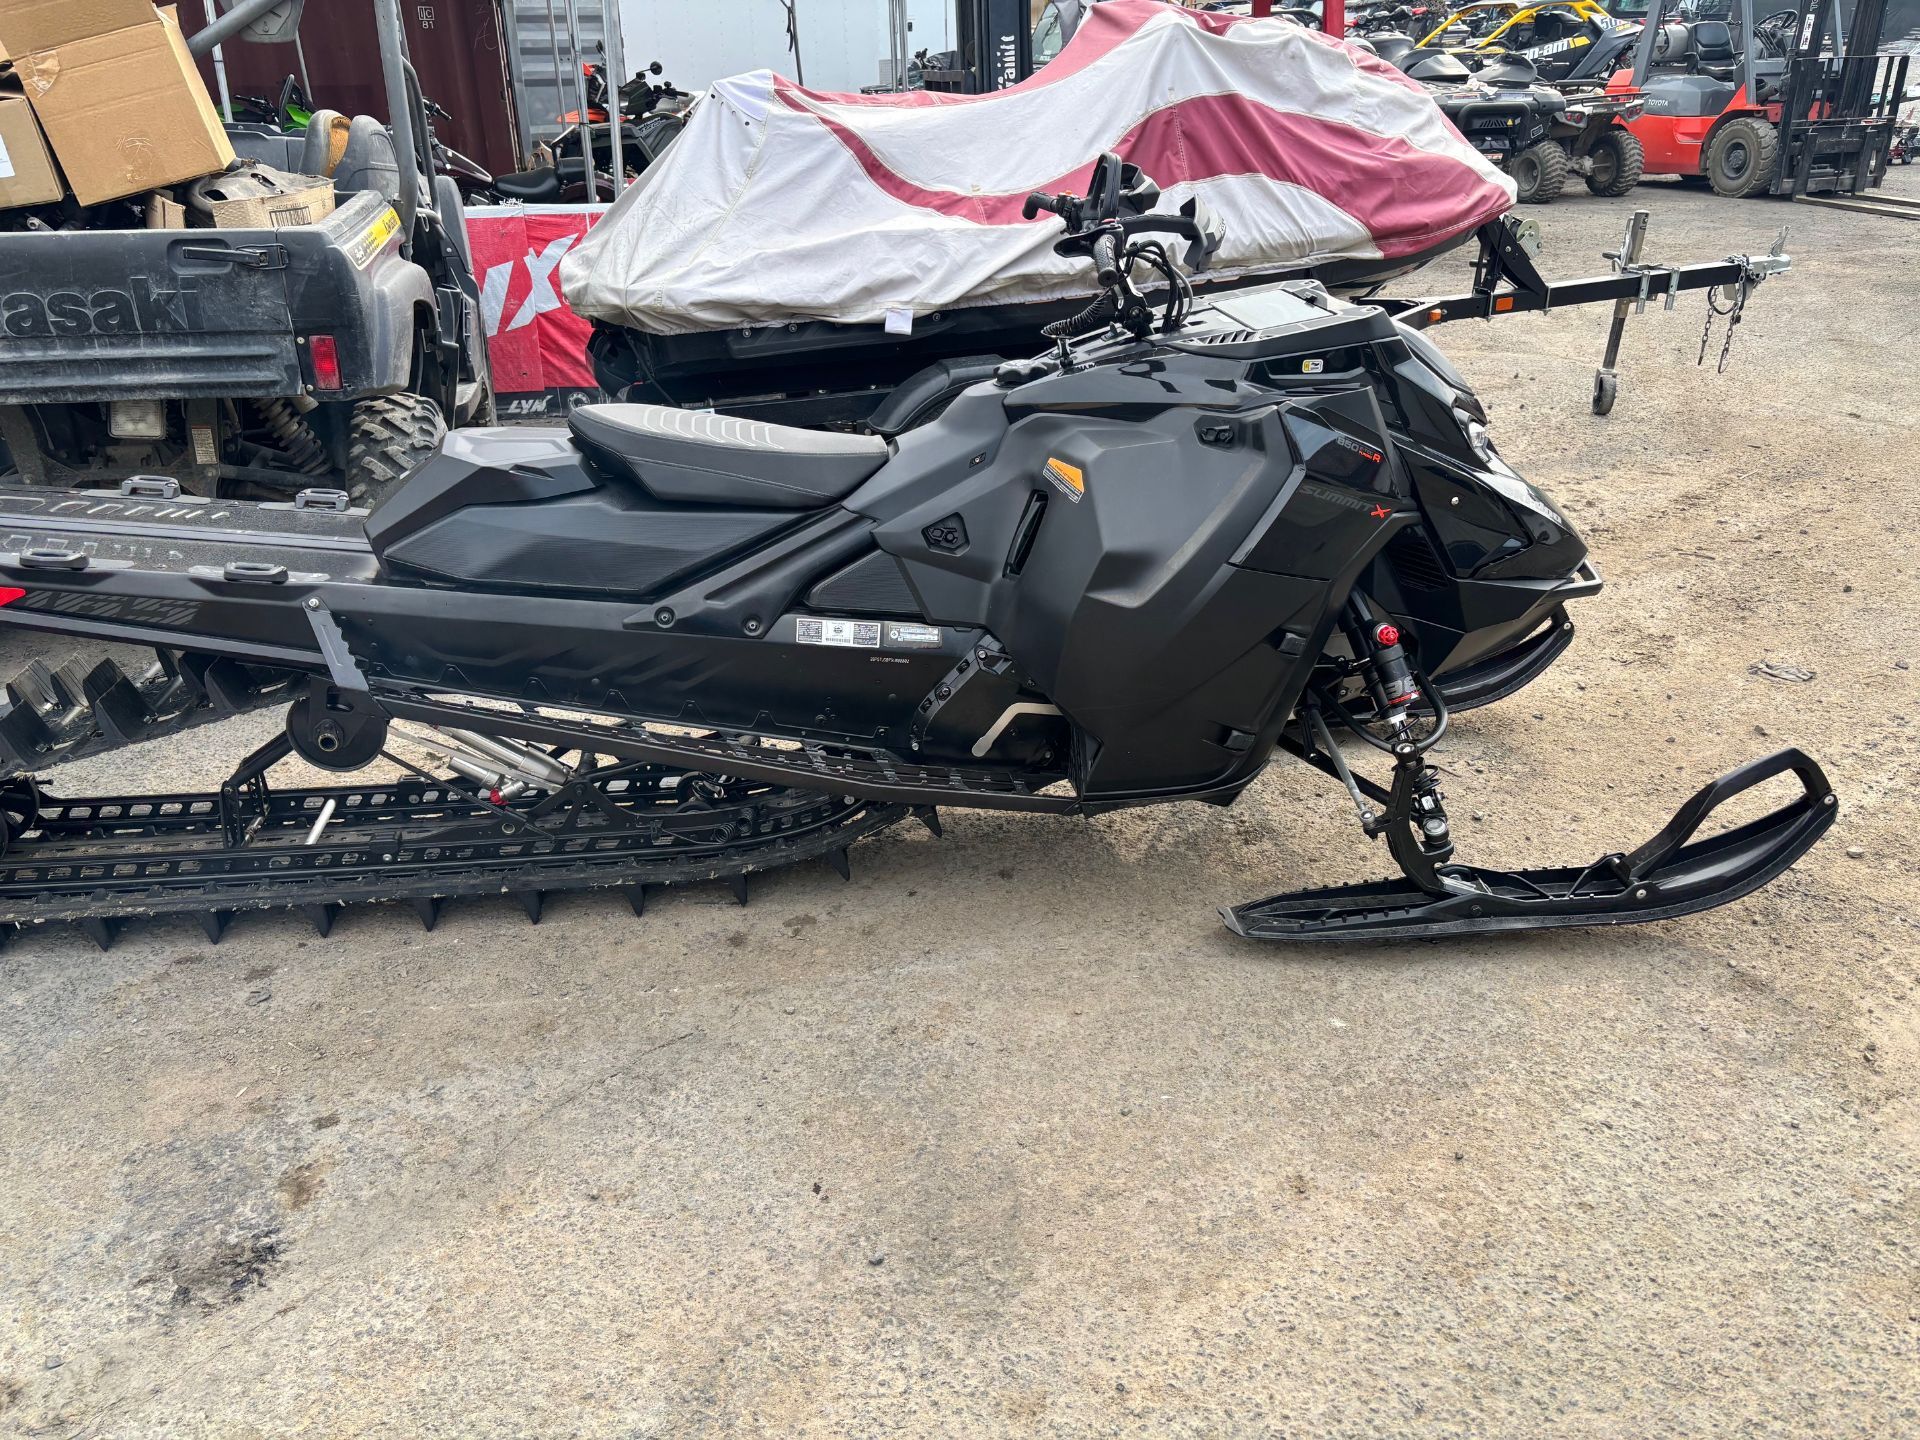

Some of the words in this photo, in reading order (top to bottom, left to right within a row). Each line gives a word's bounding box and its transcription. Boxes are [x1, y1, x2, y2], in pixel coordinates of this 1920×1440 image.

[1648, 99, 1669, 107] TOYOTA
[0, 276, 207, 338] asaki
[1336, 435, 1359, 453] 850
[1299, 484, 1375, 512] SUMMIT
[1369, 503, 1392, 519] X
